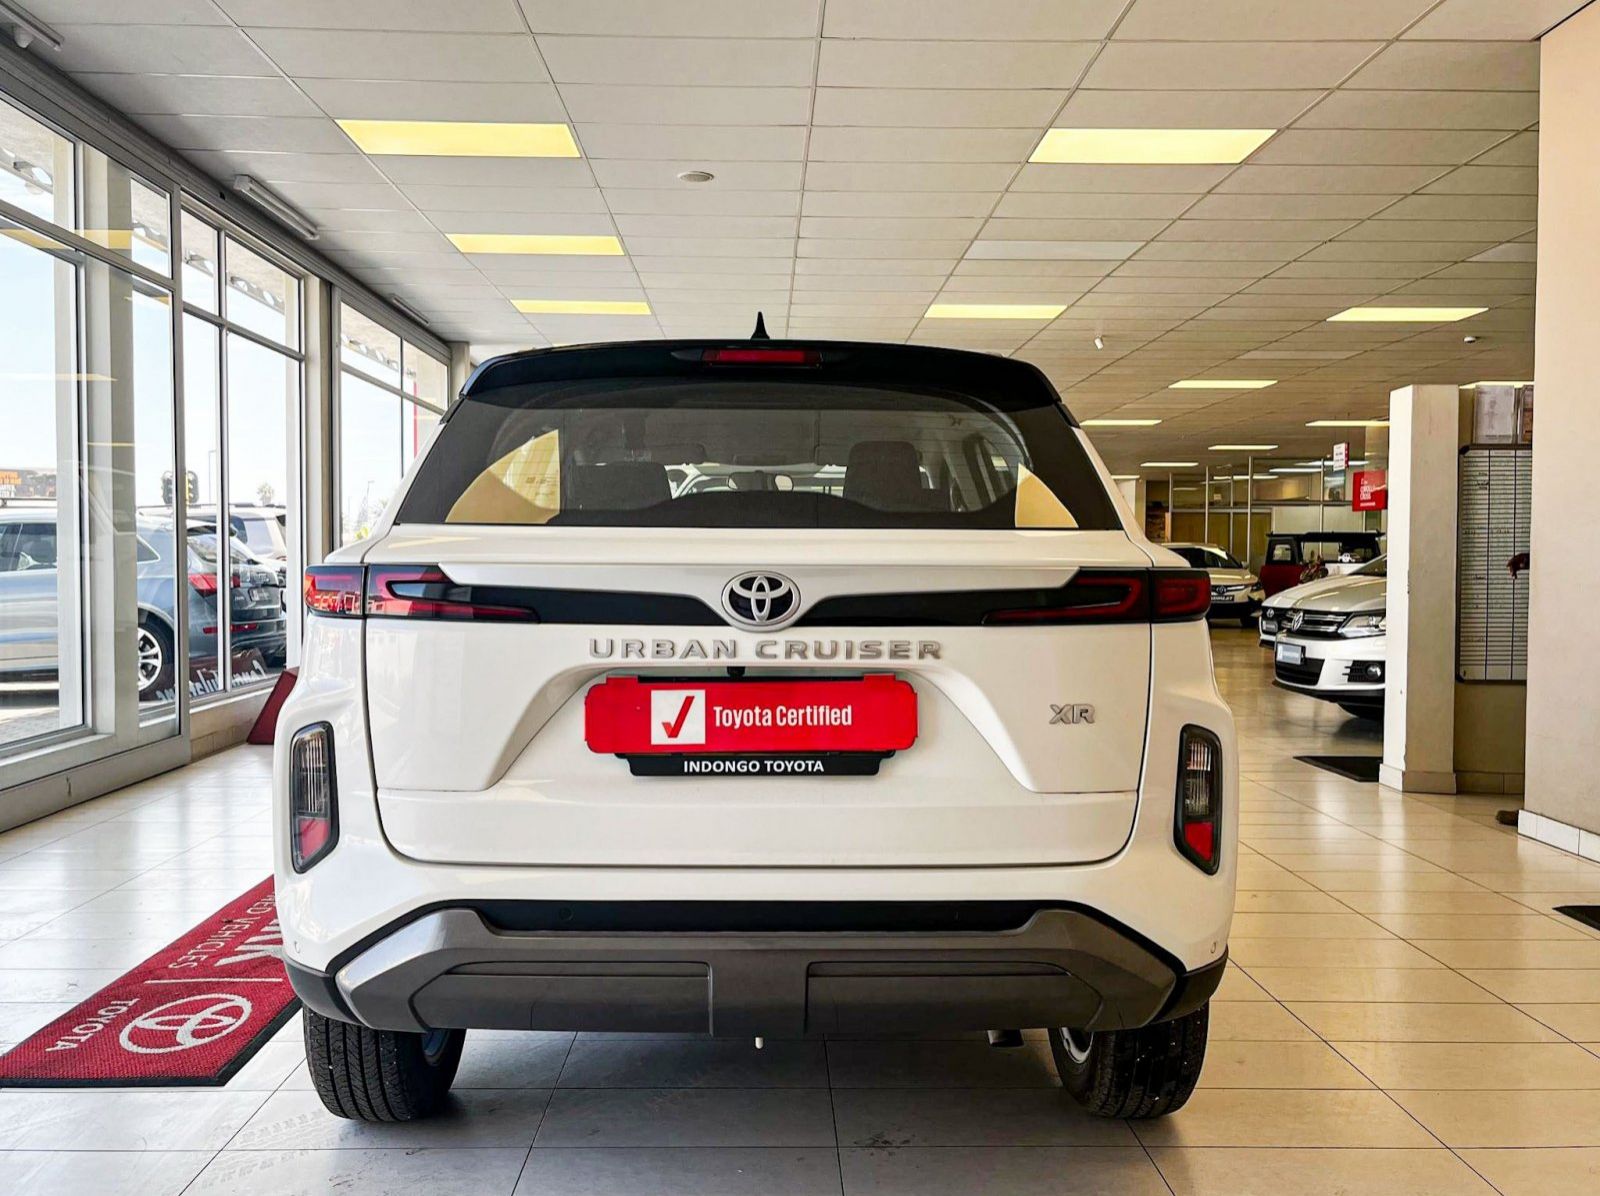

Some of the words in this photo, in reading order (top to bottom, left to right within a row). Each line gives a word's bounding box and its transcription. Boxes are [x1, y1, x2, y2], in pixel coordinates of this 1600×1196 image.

[590, 639, 737, 659] URBAN
[756, 640, 942, 660] CRUISER
[714, 706, 772, 729] Toyota
[776, 706, 852, 727] Certified
[1050, 704, 1095, 724] XR
[684, 761, 760, 773] INDONGO
[764, 761, 824, 773] TOYOTA
[45, 998, 140, 1052] TOYOTA
